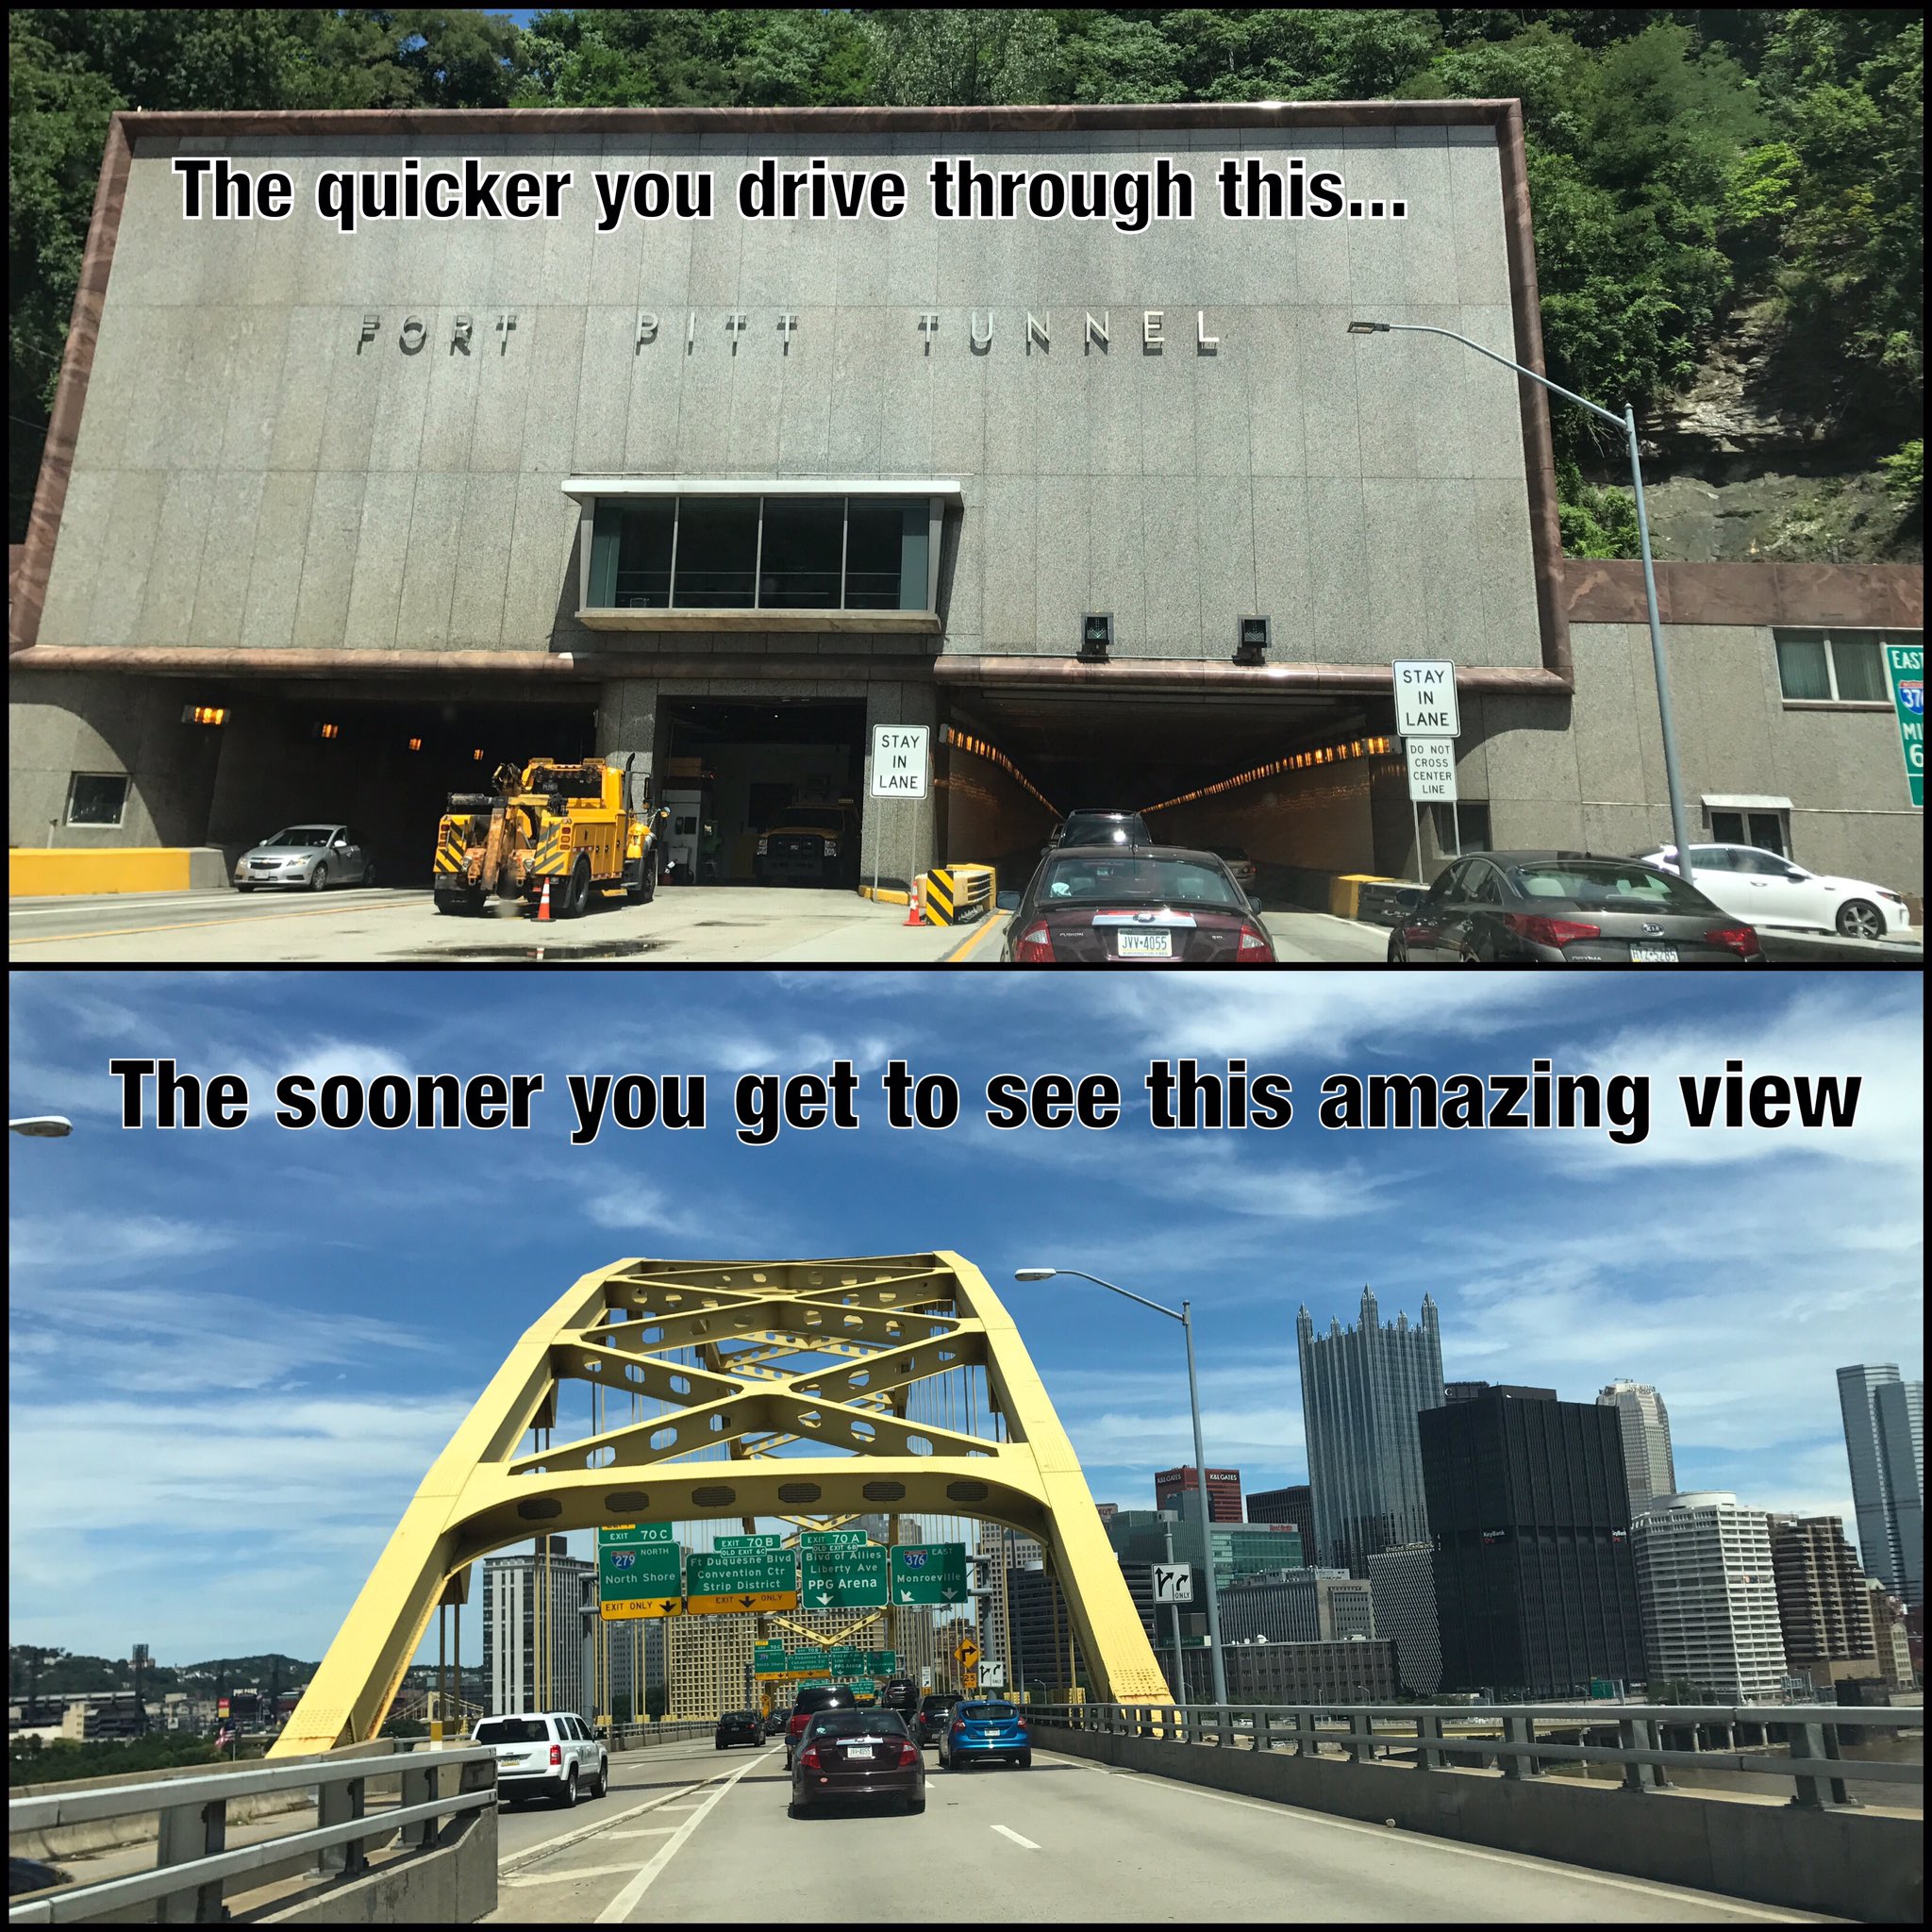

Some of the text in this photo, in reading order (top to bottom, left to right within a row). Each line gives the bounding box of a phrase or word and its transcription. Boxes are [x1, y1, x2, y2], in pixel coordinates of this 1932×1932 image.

[358, 310, 1220, 353] FORT PITT TUNNEL
[1891, 650, 1924, 669] EAST
[1403, 670, 1444, 684] STAY
[1418, 691, 1434, 705] IN
[1406, 712, 1449, 726] LANE
[881, 735, 920, 748] STAY
[1410, 745, 1451, 755] DO NOT
[892, 755, 907, 769] IN
[1415, 758, 1449, 768] CROSS
[879, 774, 918, 790] LANE
[1413, 772, 1453, 781] CENTER
[1422, 785, 1445, 794] LINE
[1165, 1474, 1182, 1482] GATES
[1483, 1529, 1505, 1538] KeyBank
[615, 1555, 635, 1566] 279
[691, 1555, 791, 1567] Ft Duquesne Blvd
[835, 1552, 844, 1560] of
[850, 1551, 882, 1559] Allies
[906, 1555, 925, 1566] 376
[697, 1567, 785, 1579] Convention Ctr
[810, 1563, 878, 1574] Liberty Ave
[606, 1573, 675, 1584] North Shore
[897, 1573, 961, 1583] Monroeville
[703, 1579, 781, 1591] Strip District
[808, 1578, 877, 1590] PPG Arena
[606, 1602, 653, 1611] EXIT ONLY
